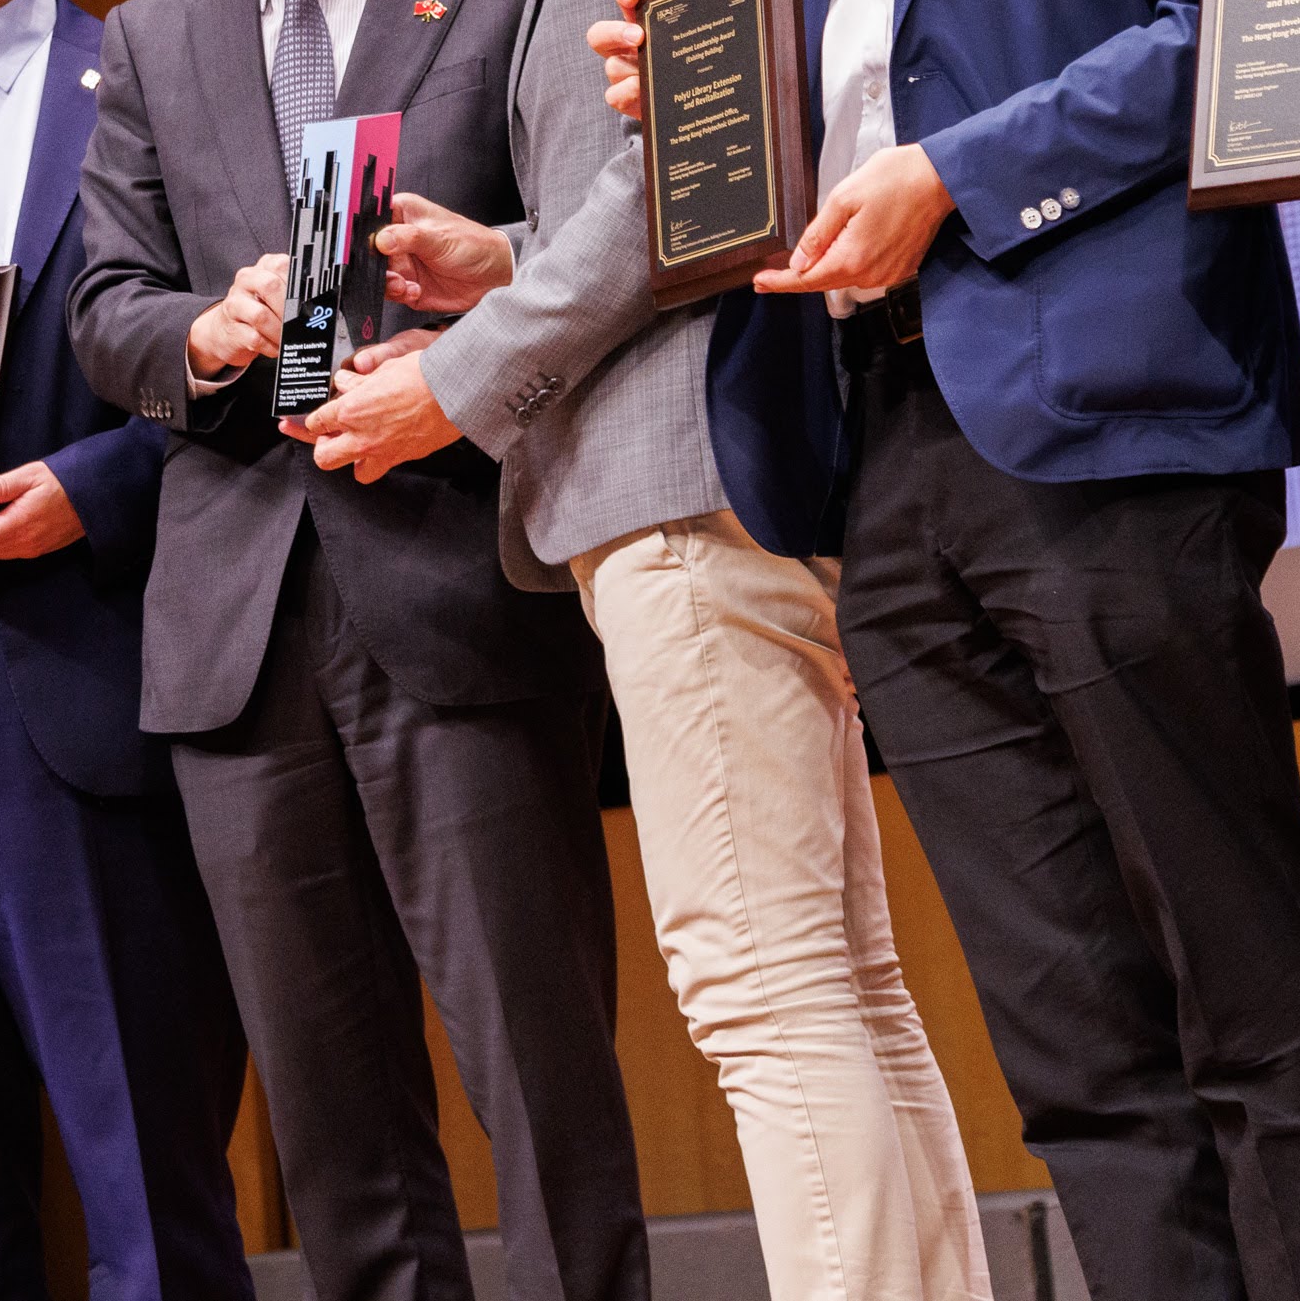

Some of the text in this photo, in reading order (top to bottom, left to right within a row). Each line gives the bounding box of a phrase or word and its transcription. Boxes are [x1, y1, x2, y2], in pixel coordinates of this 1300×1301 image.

[1241, 35, 1253, 44] The
[1254, 33, 1271, 42] Hong
[1272, 31, 1290, 39] Kong
[1255, 22, 1281, 31] Campus
[672, 29, 735, 59] Excellent Leadership Award
[686, 43, 724, 66] (Existing Building)
[674, 73, 742, 104] PolyU Library Extension
[684, 87, 735, 111] and Revitalization
[670, 112, 750, 147] The Hong Kong Polytechnic University
[678, 123, 695, 133] Campus
[696, 110, 724, 127] Development
